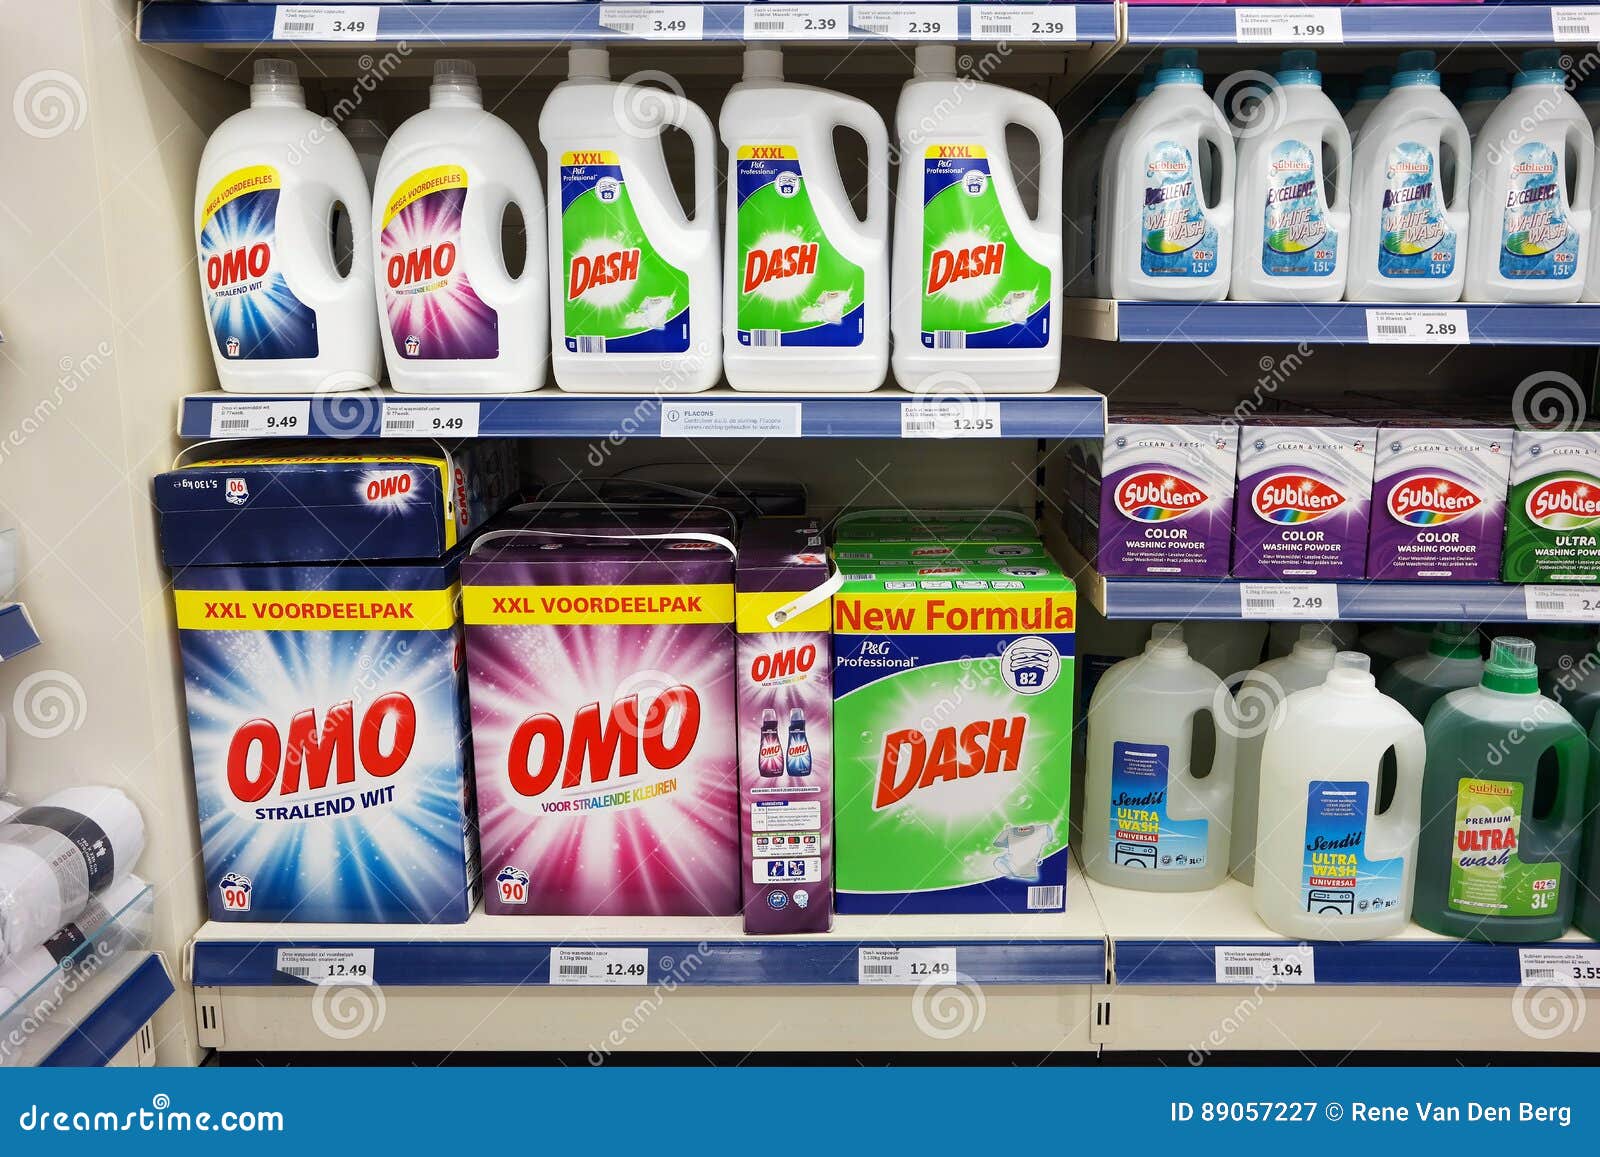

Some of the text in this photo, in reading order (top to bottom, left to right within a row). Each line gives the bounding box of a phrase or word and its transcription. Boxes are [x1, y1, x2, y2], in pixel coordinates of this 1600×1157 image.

[333, 21, 365, 32] 3.49
[653, 20, 686, 31] 3.49
[804, 19, 836, 30] 2.39
[909, 22, 941, 33] 2.39
[1031, 22, 1064, 33] 2.39
[1293, 25, 1325, 36] 1.99
[752, 148, 785, 159] XXXL
[939, 146, 972, 158] XXXL
[573, 154, 605, 164] XXXL
[751, 161, 765, 169] P&G
[937, 160, 952, 168] P&G
[572, 167, 585, 175] P&G
[206, 174, 273, 216] MEGA VOORDEELFLES
[390, 174, 461, 215] MEGA VOORDEELFLES
[1148, 209, 1190, 231] WHITE
[1270, 207, 1311, 230] WHITE
[1387, 209, 1429, 232] WHITE
[1509, 210, 1552, 233] WHITE
[1168, 220, 1205, 241] WASH
[1289, 220, 1326, 241] WASH
[1406, 222, 1444, 241] WASH
[1529, 223, 1568, 243] WASH
[1194, 251, 1204, 259] 20
[207, 242, 271, 290] OMO
[387, 241, 456, 288] OMO
[744, 243, 818, 294] DASH
[927, 243, 1005, 295] DASH
[569, 249, 640, 300] DASH
[215, 281, 263, 298] STRALEND WIT
[1425, 323, 1456, 334] 2.89
[228, 345, 238, 355] 77
[407, 344, 417, 354] 77
[267, 416, 297, 428] 9.49
[432, 417, 463, 429] 9.49
[954, 418, 994, 430] 12.95
[230, 481, 244, 492] 90
[366, 473, 411, 501] OMO
[455, 468, 468, 526] OMO
[1124, 482, 1201, 508] Subliem
[1261, 484, 1338, 510] Subliem
[1397, 486, 1475, 512] Subliem
[1144, 528, 1188, 539] COLOR
[1281, 531, 1325, 541] COLOR
[1416, 532, 1460, 543] COLOR
[1125, 540, 1205, 549] WASHING POWDER
[1262, 543, 1341, 551] WASHING POWDER
[1555, 536, 1597, 546] ULTRA
[1397, 545, 1476, 553] WASHING POWDER
[1534, 548, 1600, 556] WASHING POW
[492, 596, 702, 613] XXL VOORDEELPAK
[1292, 597, 1322, 608] 2.49
[205, 602, 414, 619] XXL VOORDEELPAK
[836, 597, 1073, 631] New Formula
[860, 641, 891, 655] P&G
[751, 643, 817, 683] OMO
[1019, 672, 1037, 685] 82
[227, 691, 417, 803] OMO
[507, 684, 701, 797] OMO
[761, 745, 780, 757] OMO
[788, 744, 808, 756] OMO
[875, 716, 1027, 809] DASH
[541, 777, 677, 813] VOOR STRALENDE KLEUREN
[1113, 791, 1165, 806] Sendil
[255, 785, 395, 820] STRALEND WIT
[1117, 807, 1159, 822] ULTRA
[1465, 815, 1511, 825] PREMIUM
[1118, 820, 1159, 833] WASH
[1118, 832, 1157, 841] UNIVERSAL
[1307, 832, 1362, 851] Sendil
[1457, 828, 1517, 851] ULTRA
[1312, 853, 1357, 865] ULTRA
[1460, 848, 1510, 867] wash
[1312, 865, 1357, 877] WASH
[1312, 878, 1354, 886] UNIVERSAL
[1534, 881, 1545, 890] 42
[502, 882, 523, 900] 90
[225, 890, 246, 907] 90
[328, 965, 367, 976] 12.49
[606, 963, 645, 976] 12.49
[910, 963, 949, 975] 12.49
[1272, 964, 1302, 976] 1.94
